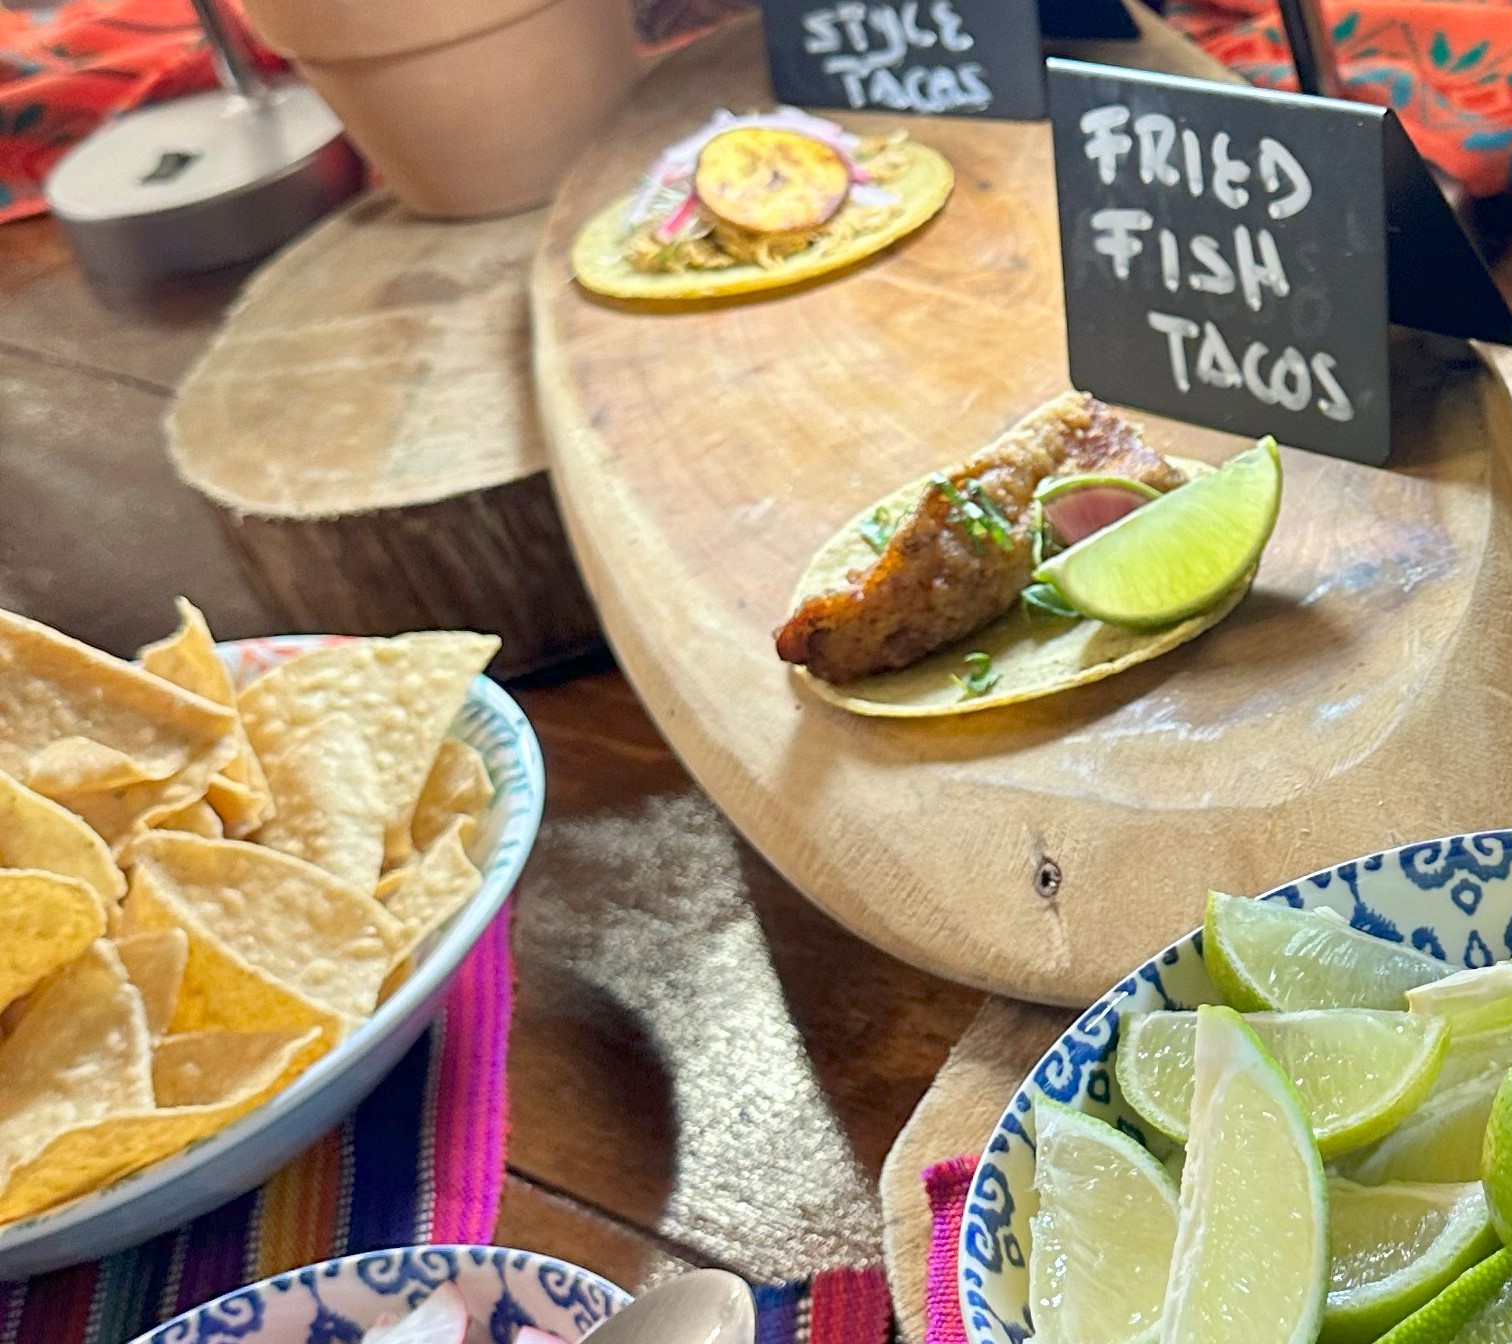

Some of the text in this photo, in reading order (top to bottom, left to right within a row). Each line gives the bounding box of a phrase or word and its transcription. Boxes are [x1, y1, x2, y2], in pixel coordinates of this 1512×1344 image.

[823, 54, 992, 113] TACOS
[1080, 104, 1313, 220] FRIED
[1091, 208, 1291, 312] FISH
[1147, 310, 1354, 422] TACOS
